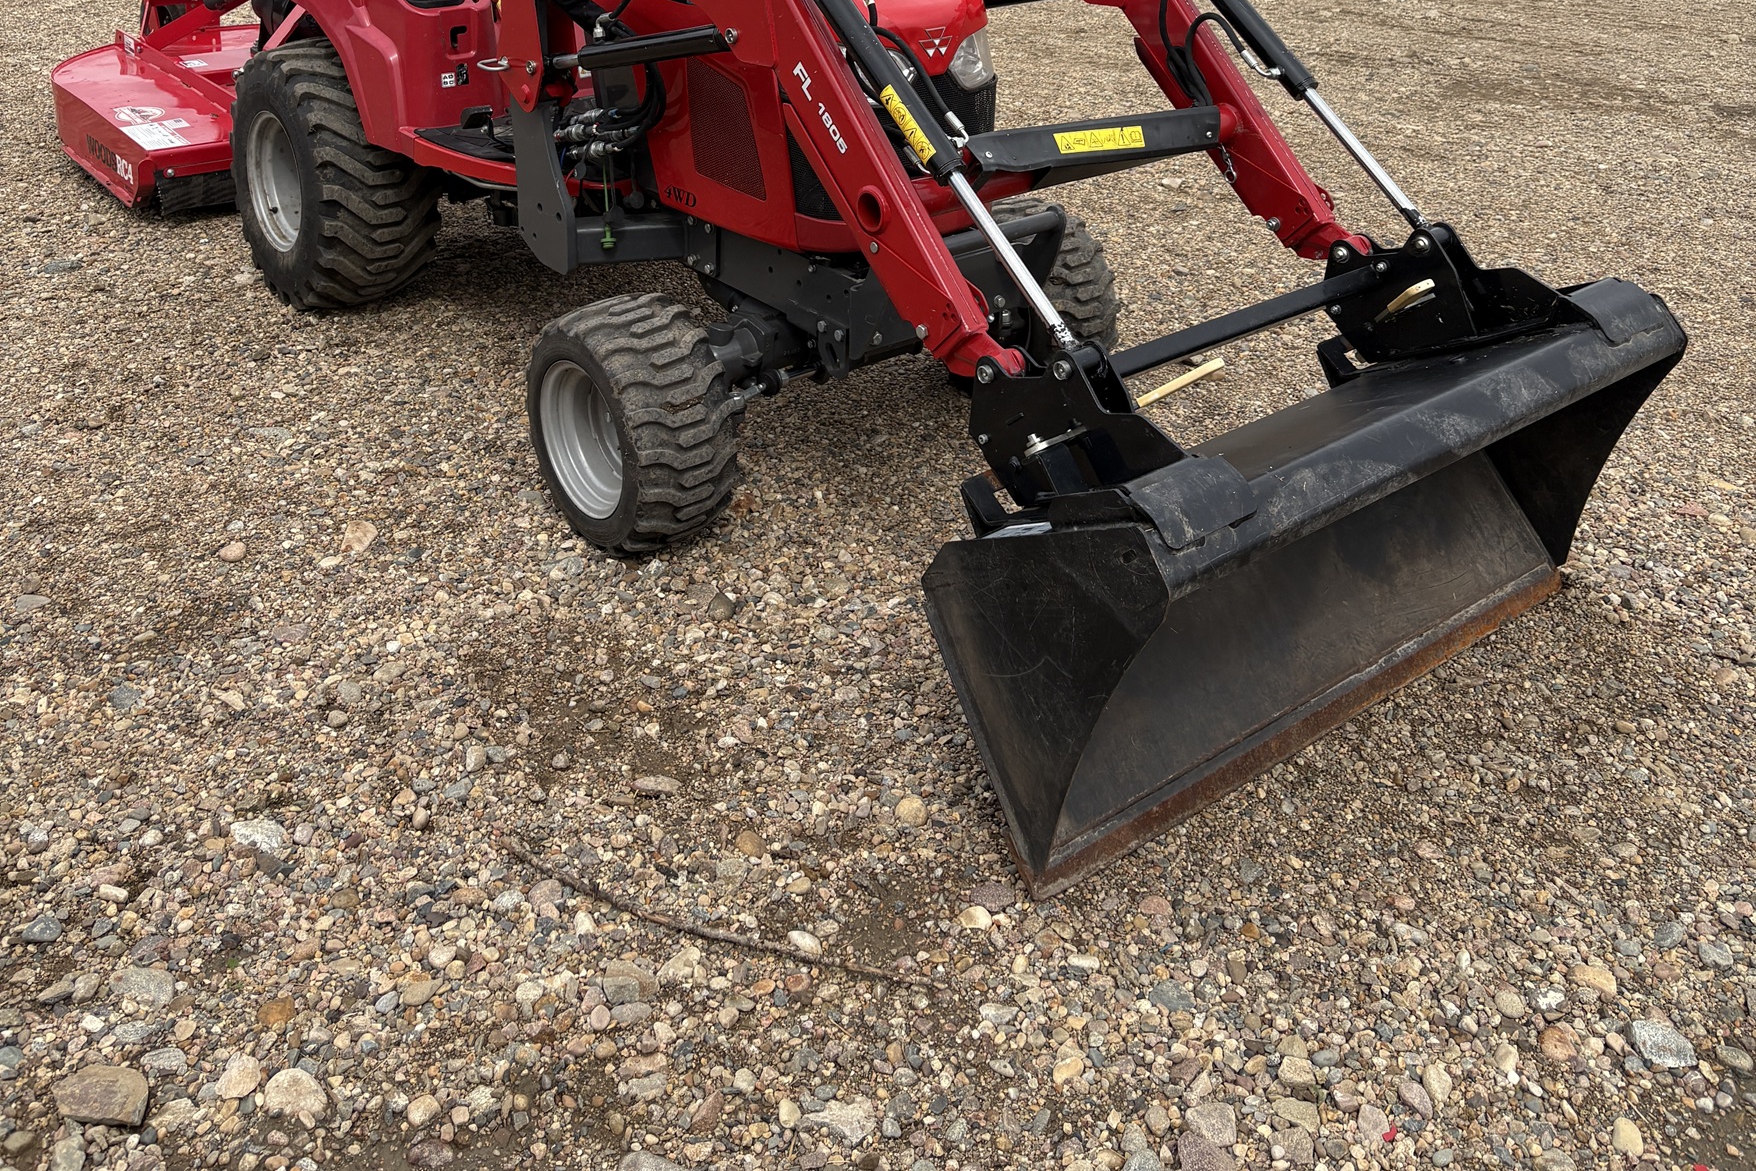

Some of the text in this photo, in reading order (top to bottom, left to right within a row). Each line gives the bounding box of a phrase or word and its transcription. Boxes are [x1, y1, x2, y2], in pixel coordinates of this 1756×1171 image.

[792, 61, 848, 154] FL 1805
[664, 184, 697, 208] 4WD
